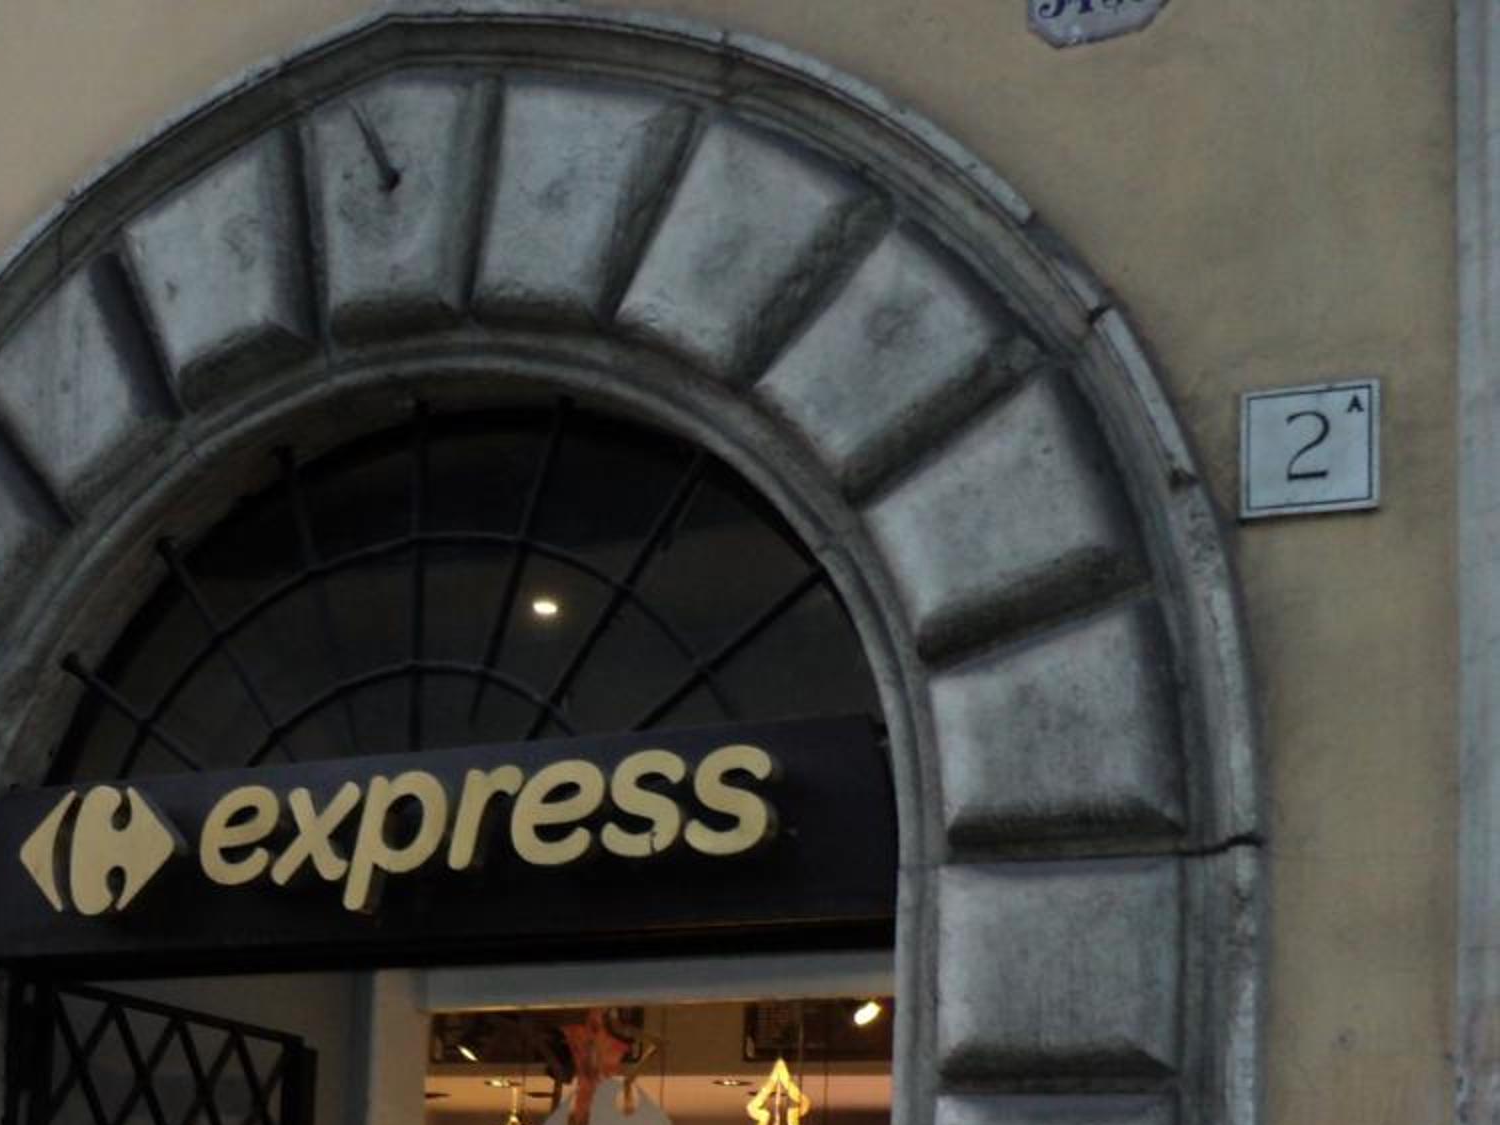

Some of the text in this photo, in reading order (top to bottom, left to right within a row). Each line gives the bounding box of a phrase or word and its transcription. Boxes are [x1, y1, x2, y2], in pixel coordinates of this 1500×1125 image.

[1286, 394, 1364, 482] 2 A
[199, 744, 776, 912] express
